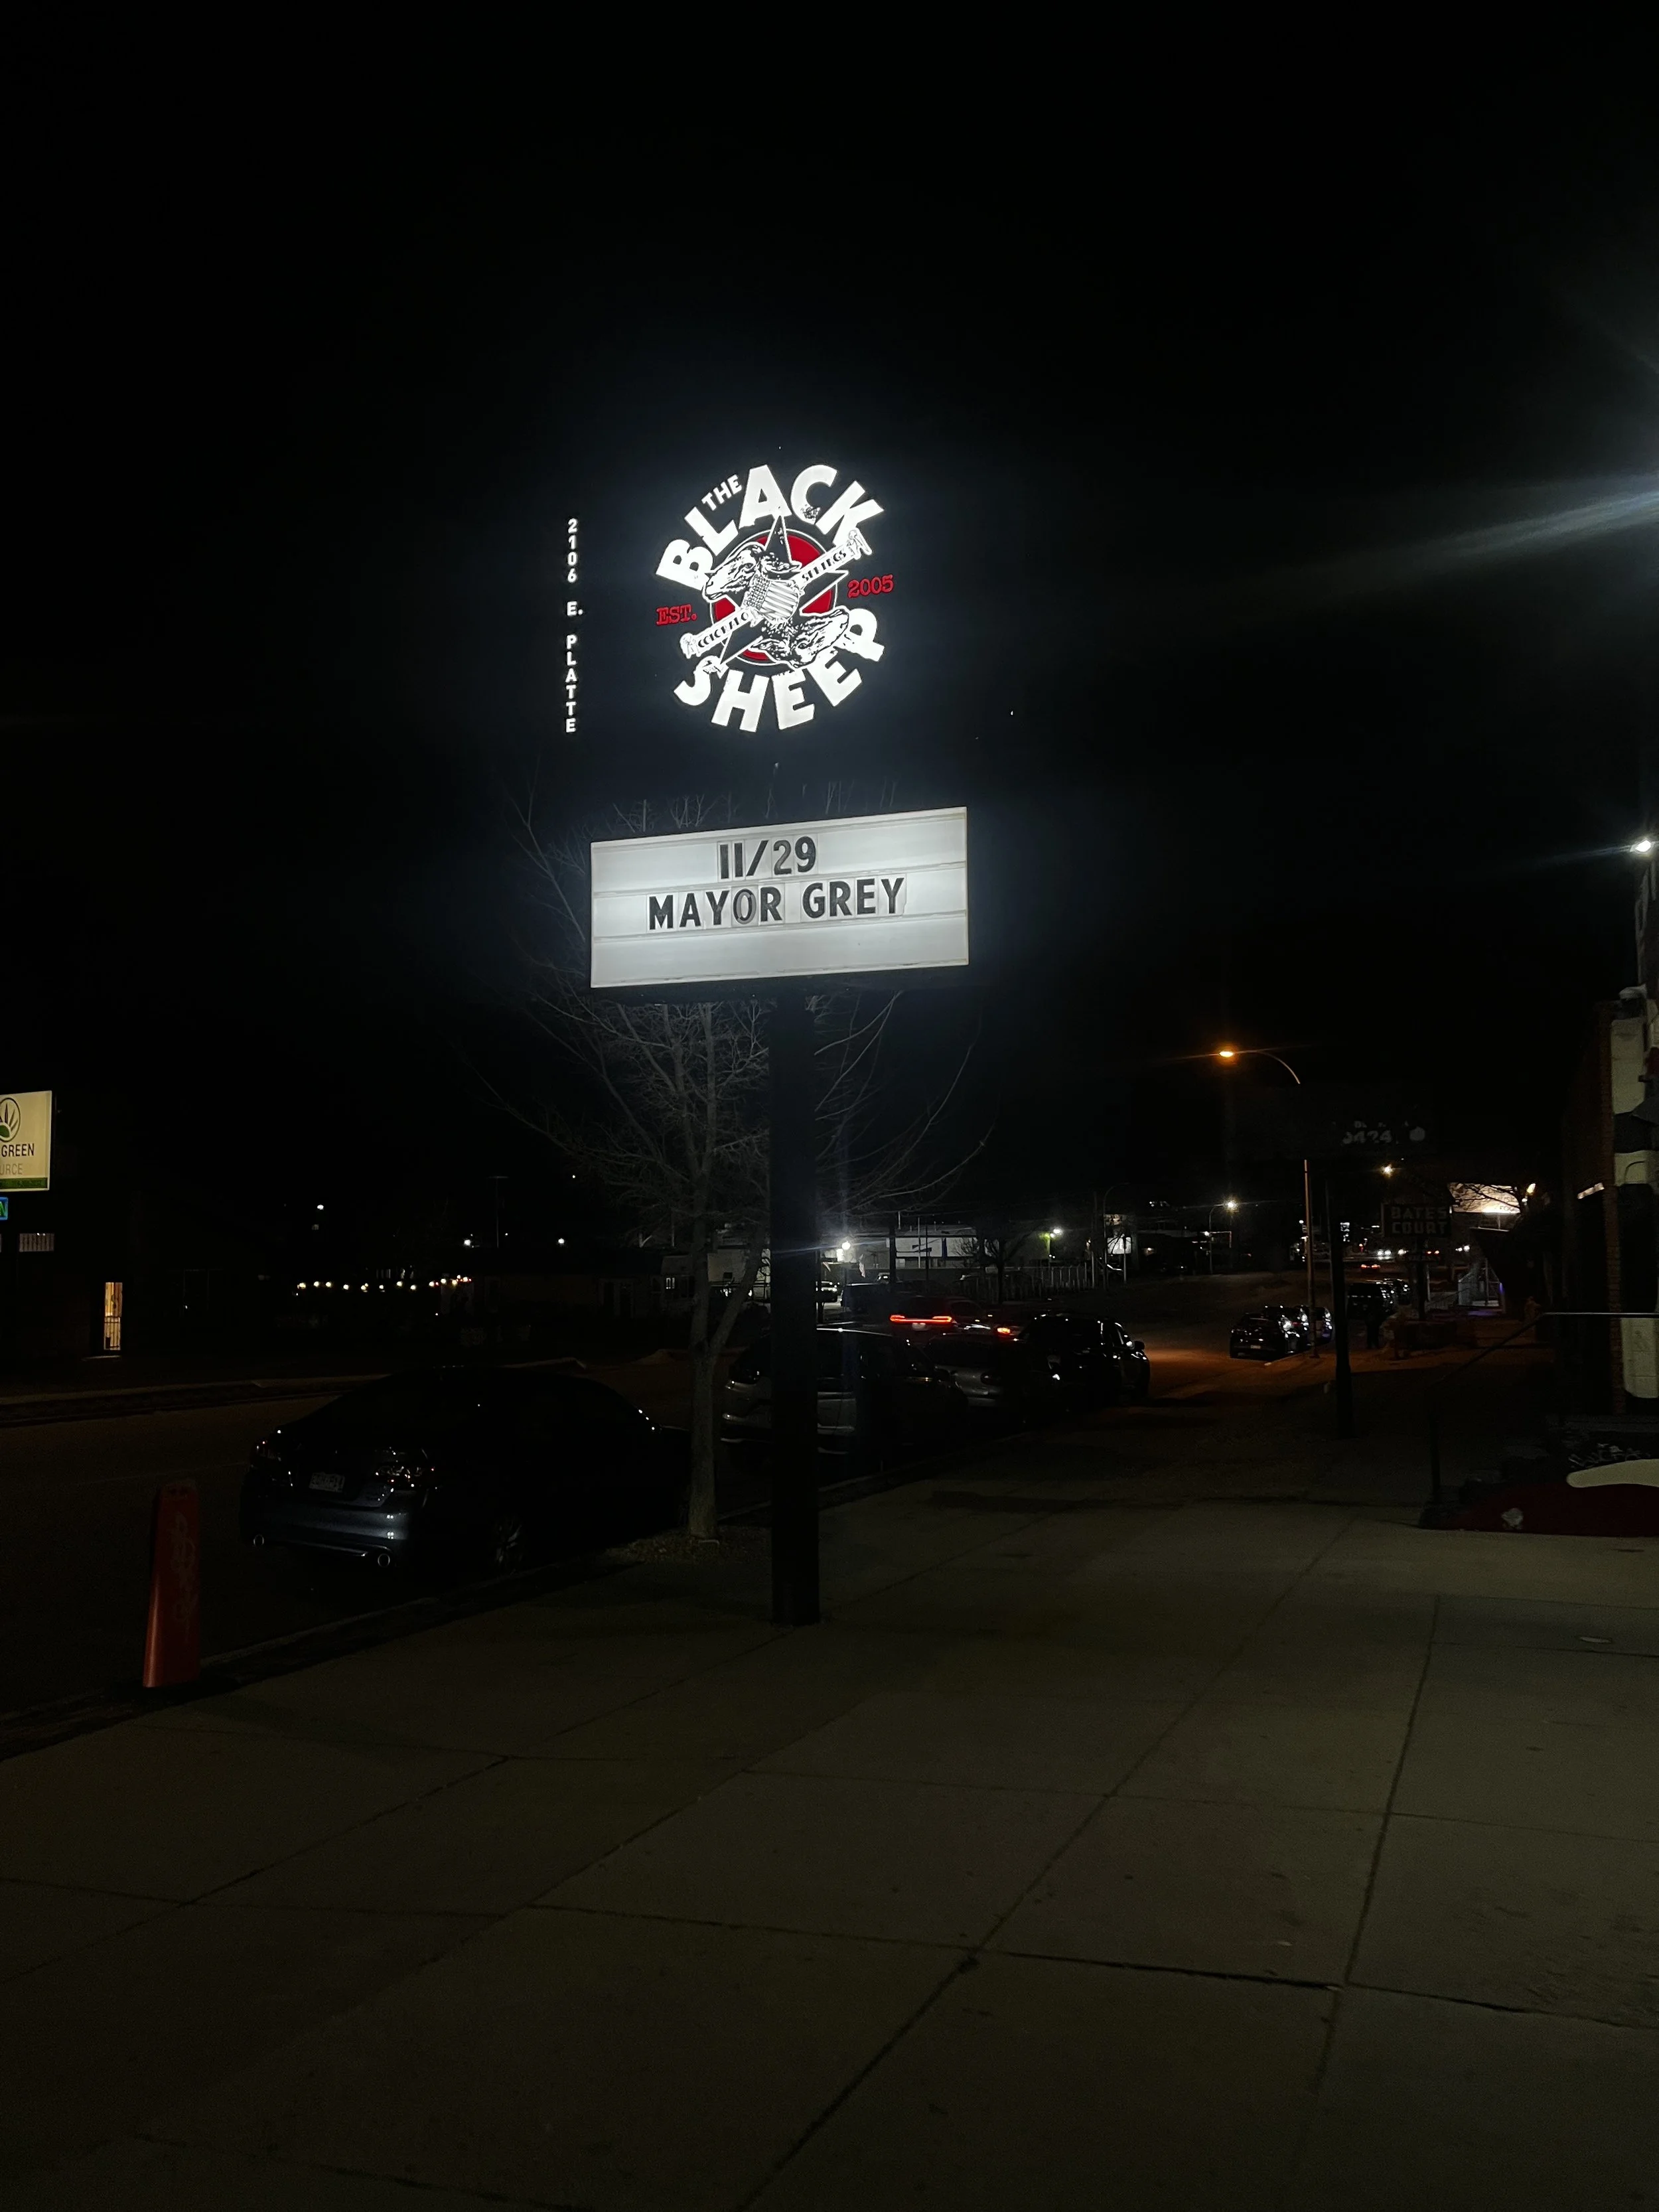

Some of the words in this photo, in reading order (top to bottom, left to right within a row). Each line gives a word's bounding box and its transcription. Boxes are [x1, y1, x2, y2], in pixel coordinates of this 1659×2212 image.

[701, 475, 743, 512] THE
[656, 465, 885, 591] BLACK
[567, 518, 577, 583] 2106
[847, 574, 894, 598] 2005
[567, 601, 583, 616] E.
[656, 605, 697, 626] EST.
[565, 634, 577, 733] PLATTE
[674, 608, 885, 733] SHEEP
[719, 836, 817, 880] 11/29
[648, 887, 783, 930] MAYOR
[802, 877, 905, 919] GREY
[1, 1143, 35, 1157] GREEN
[1392, 1221, 1448, 1234] COURT
